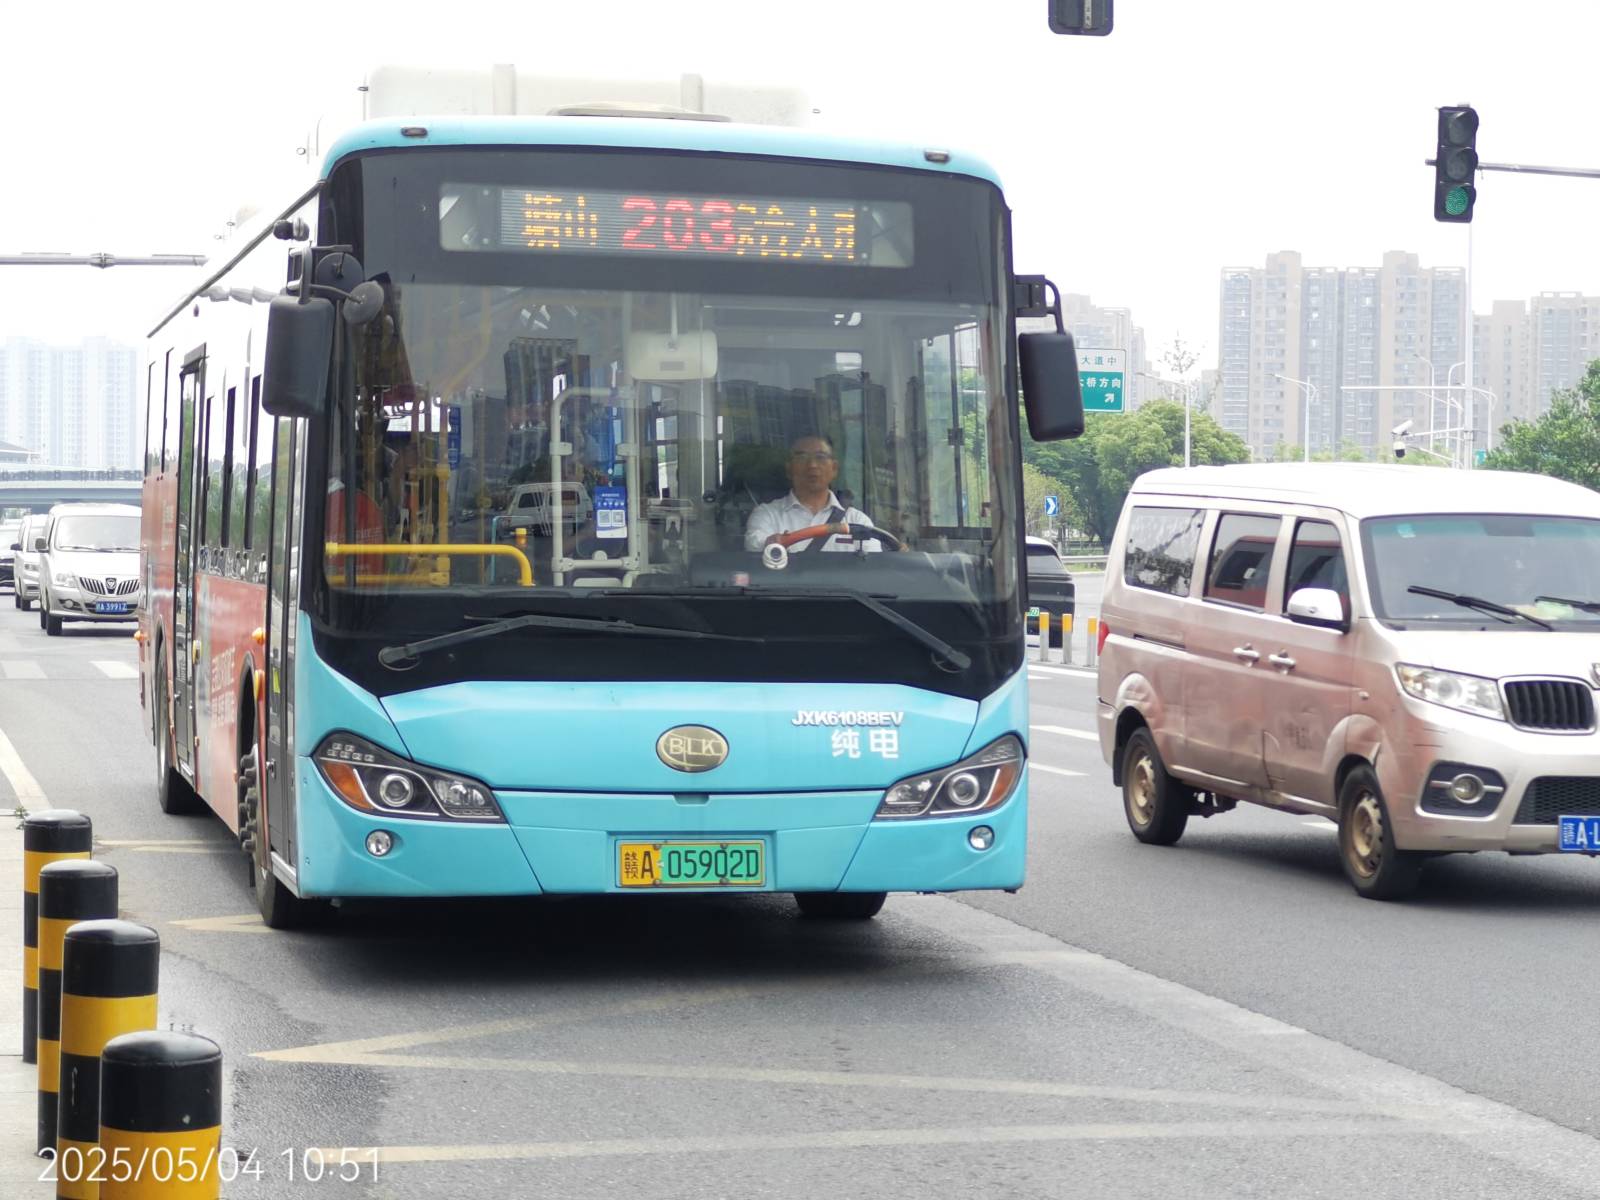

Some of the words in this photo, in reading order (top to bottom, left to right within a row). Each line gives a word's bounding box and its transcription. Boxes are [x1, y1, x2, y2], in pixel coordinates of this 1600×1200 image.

[621, 195, 737, 251] 203
[792, 710, 904, 727] JXK6108BEV
[668, 737, 716, 756] BLK
[831, 728, 899, 759] 纯电
